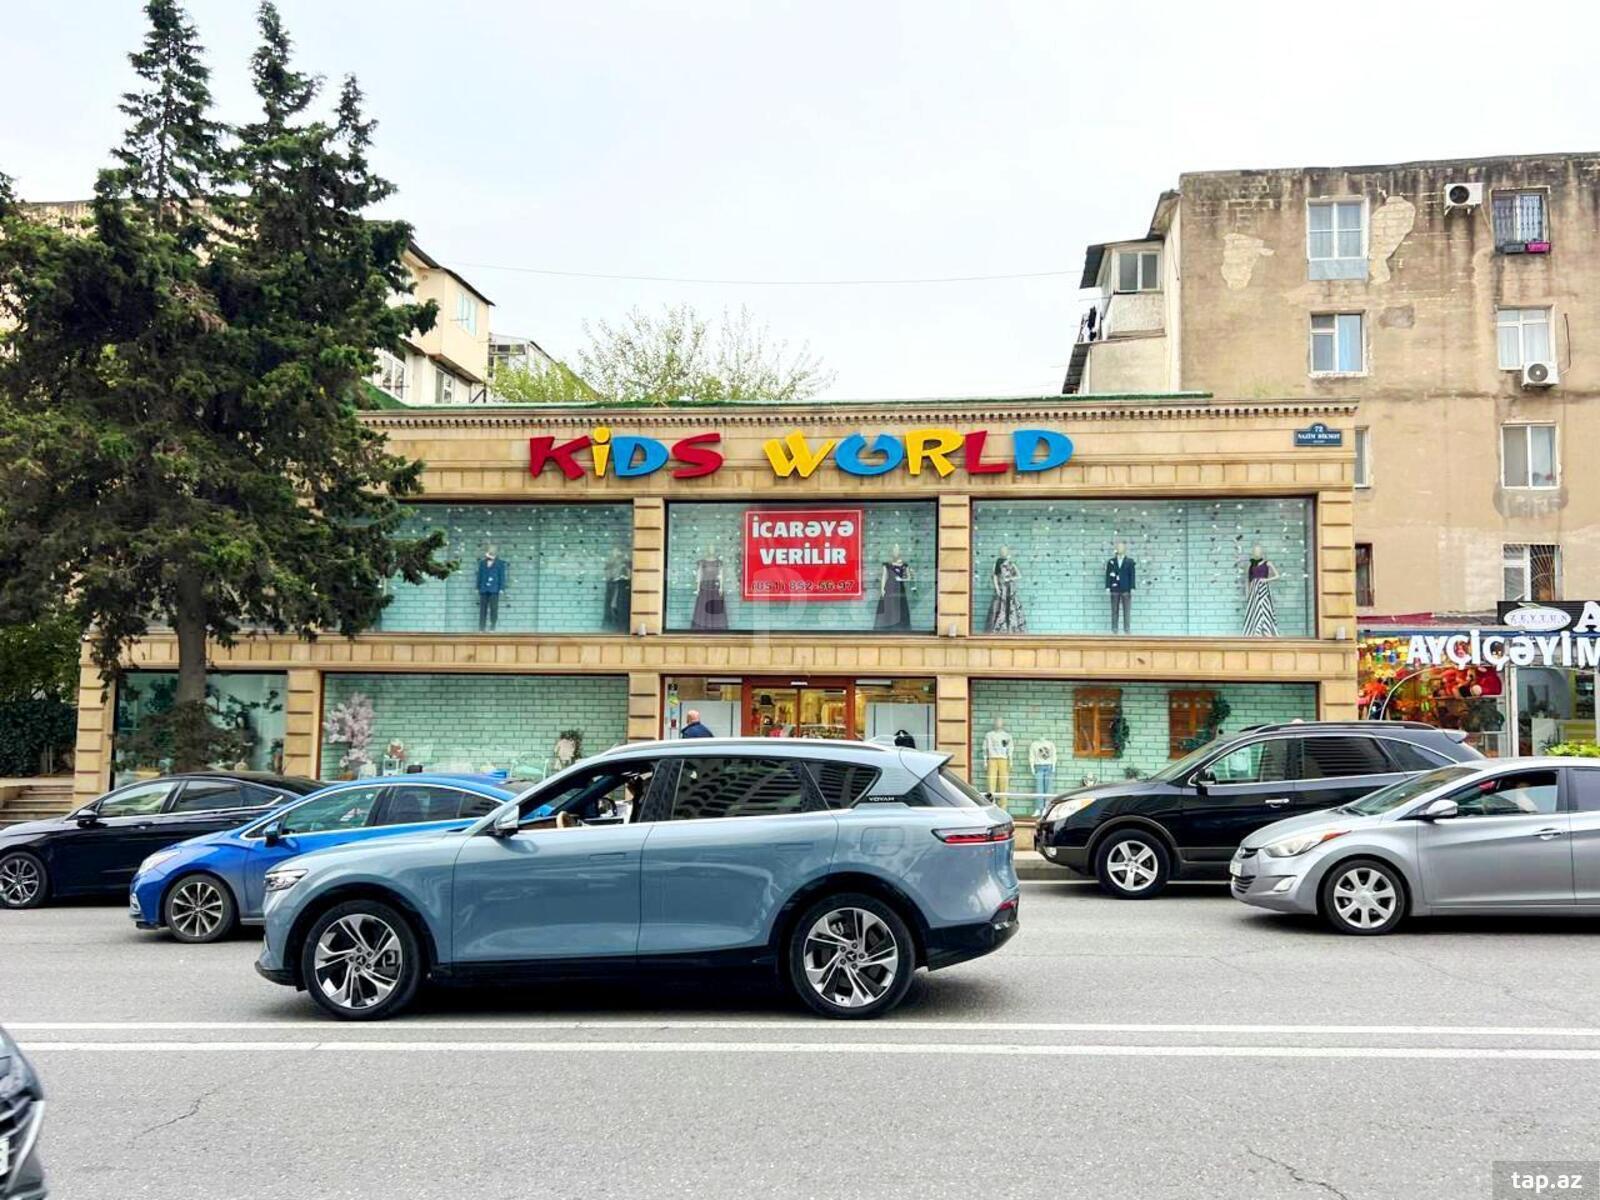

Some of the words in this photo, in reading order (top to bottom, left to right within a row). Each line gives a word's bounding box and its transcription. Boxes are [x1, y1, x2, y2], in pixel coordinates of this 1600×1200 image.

[763, 429, 1074, 478] WORLD
[752, 515, 854, 538] İCARƏYƏ
[760, 542, 847, 565] VERİLİR
